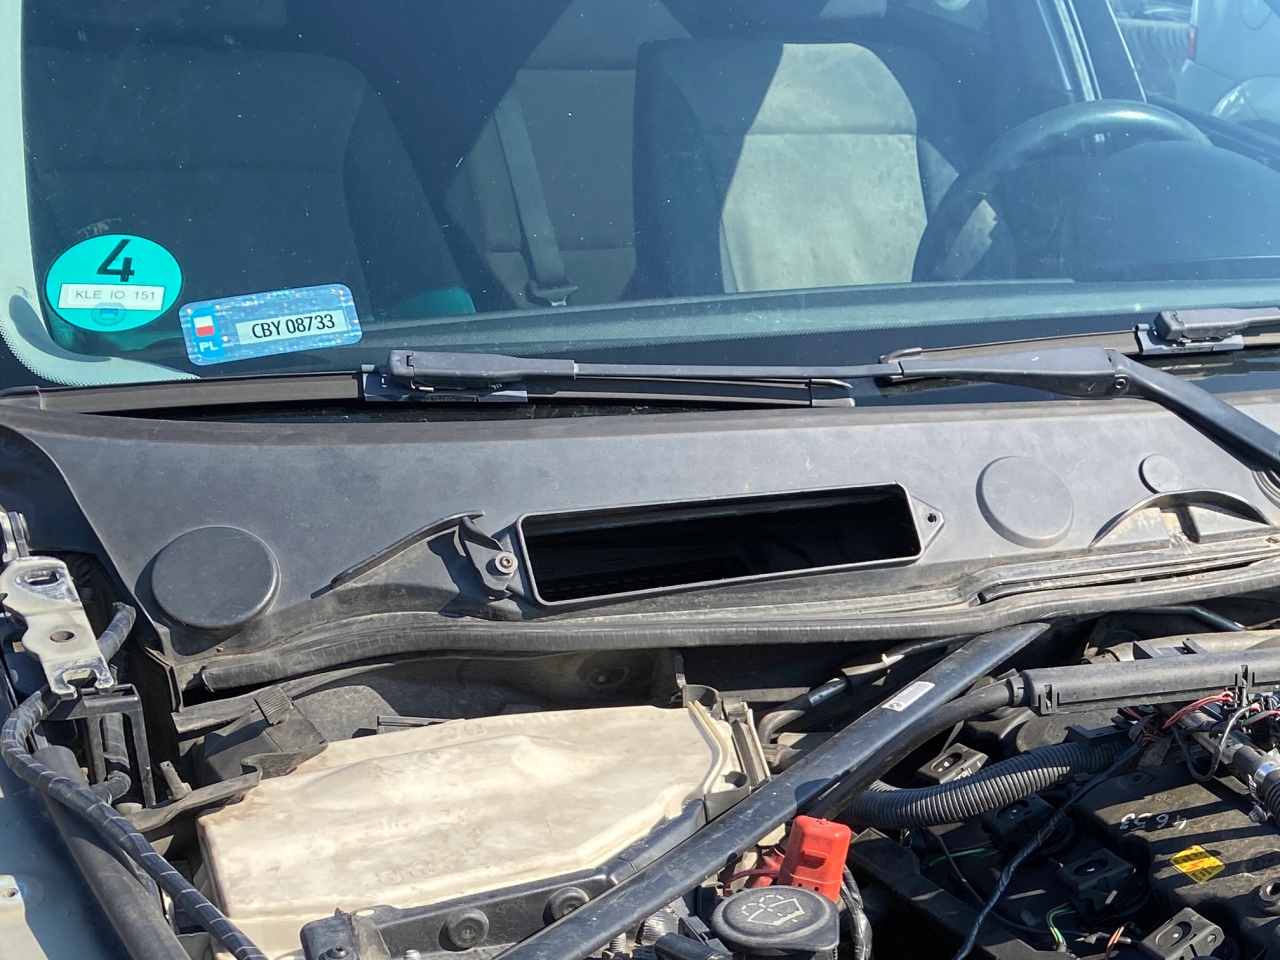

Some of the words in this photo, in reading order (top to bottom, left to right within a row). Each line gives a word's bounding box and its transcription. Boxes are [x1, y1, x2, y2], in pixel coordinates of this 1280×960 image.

[96, 238, 135, 282] 4
[75, 290, 102, 300] KLE
[134, 291, 155, 300] 151
[252, 321, 282, 339] CBY
[285, 313, 336, 334] 08733
[198, 340, 219, 352] PL
